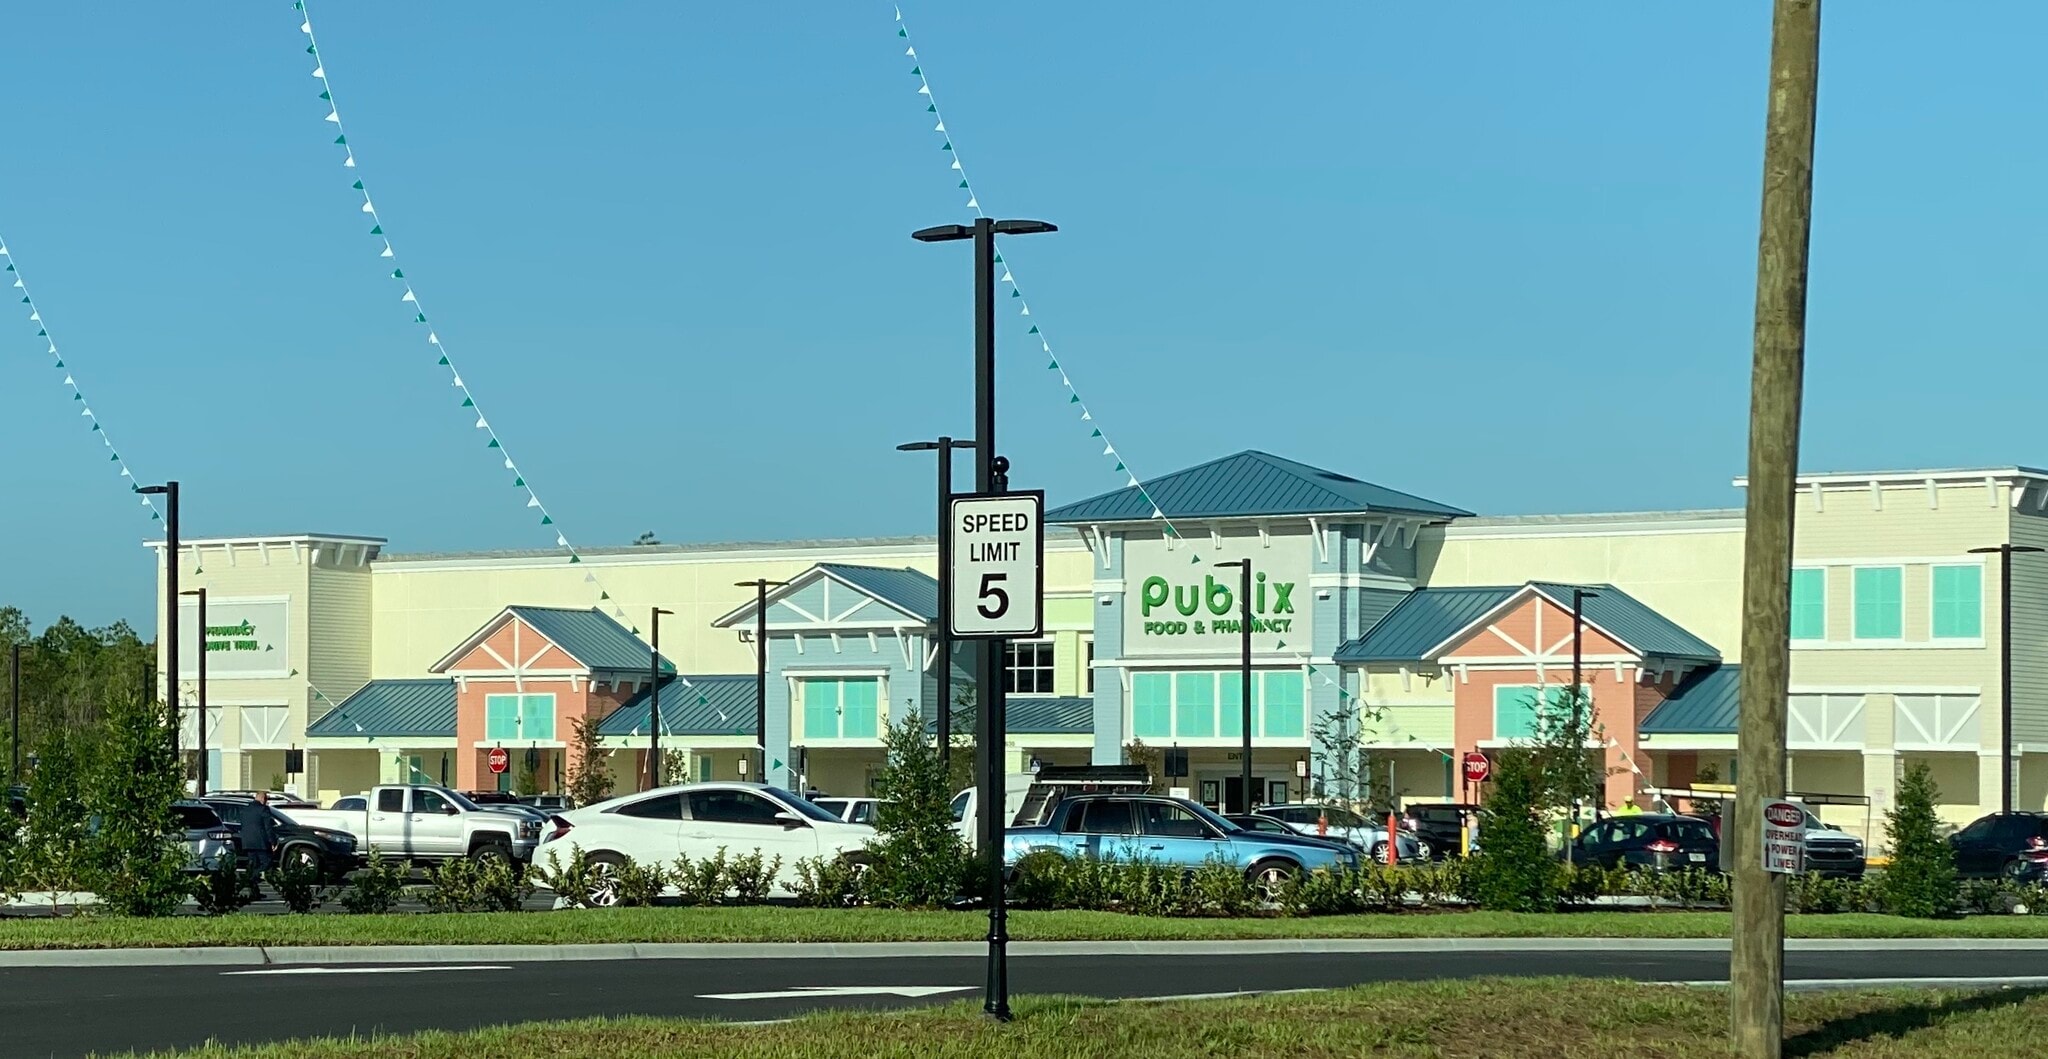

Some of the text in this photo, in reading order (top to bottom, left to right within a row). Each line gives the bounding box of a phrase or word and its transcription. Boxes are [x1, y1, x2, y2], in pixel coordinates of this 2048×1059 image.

[963, 513, 1028, 533] SPEED
[970, 542, 1020, 562] LIMIT
[977, 573, 1009, 619] 5
[1142, 572, 1295, 617] Pubix
[1144, 619, 1291, 635] FOOD & PHAMACY
[490, 755, 506, 765] STOP
[1767, 808, 1801, 823] DANGER
[1765, 829, 1803, 842] OVERHEAD
[1771, 843, 1797, 856] POWER
[1773, 858, 1796, 869] LINES
